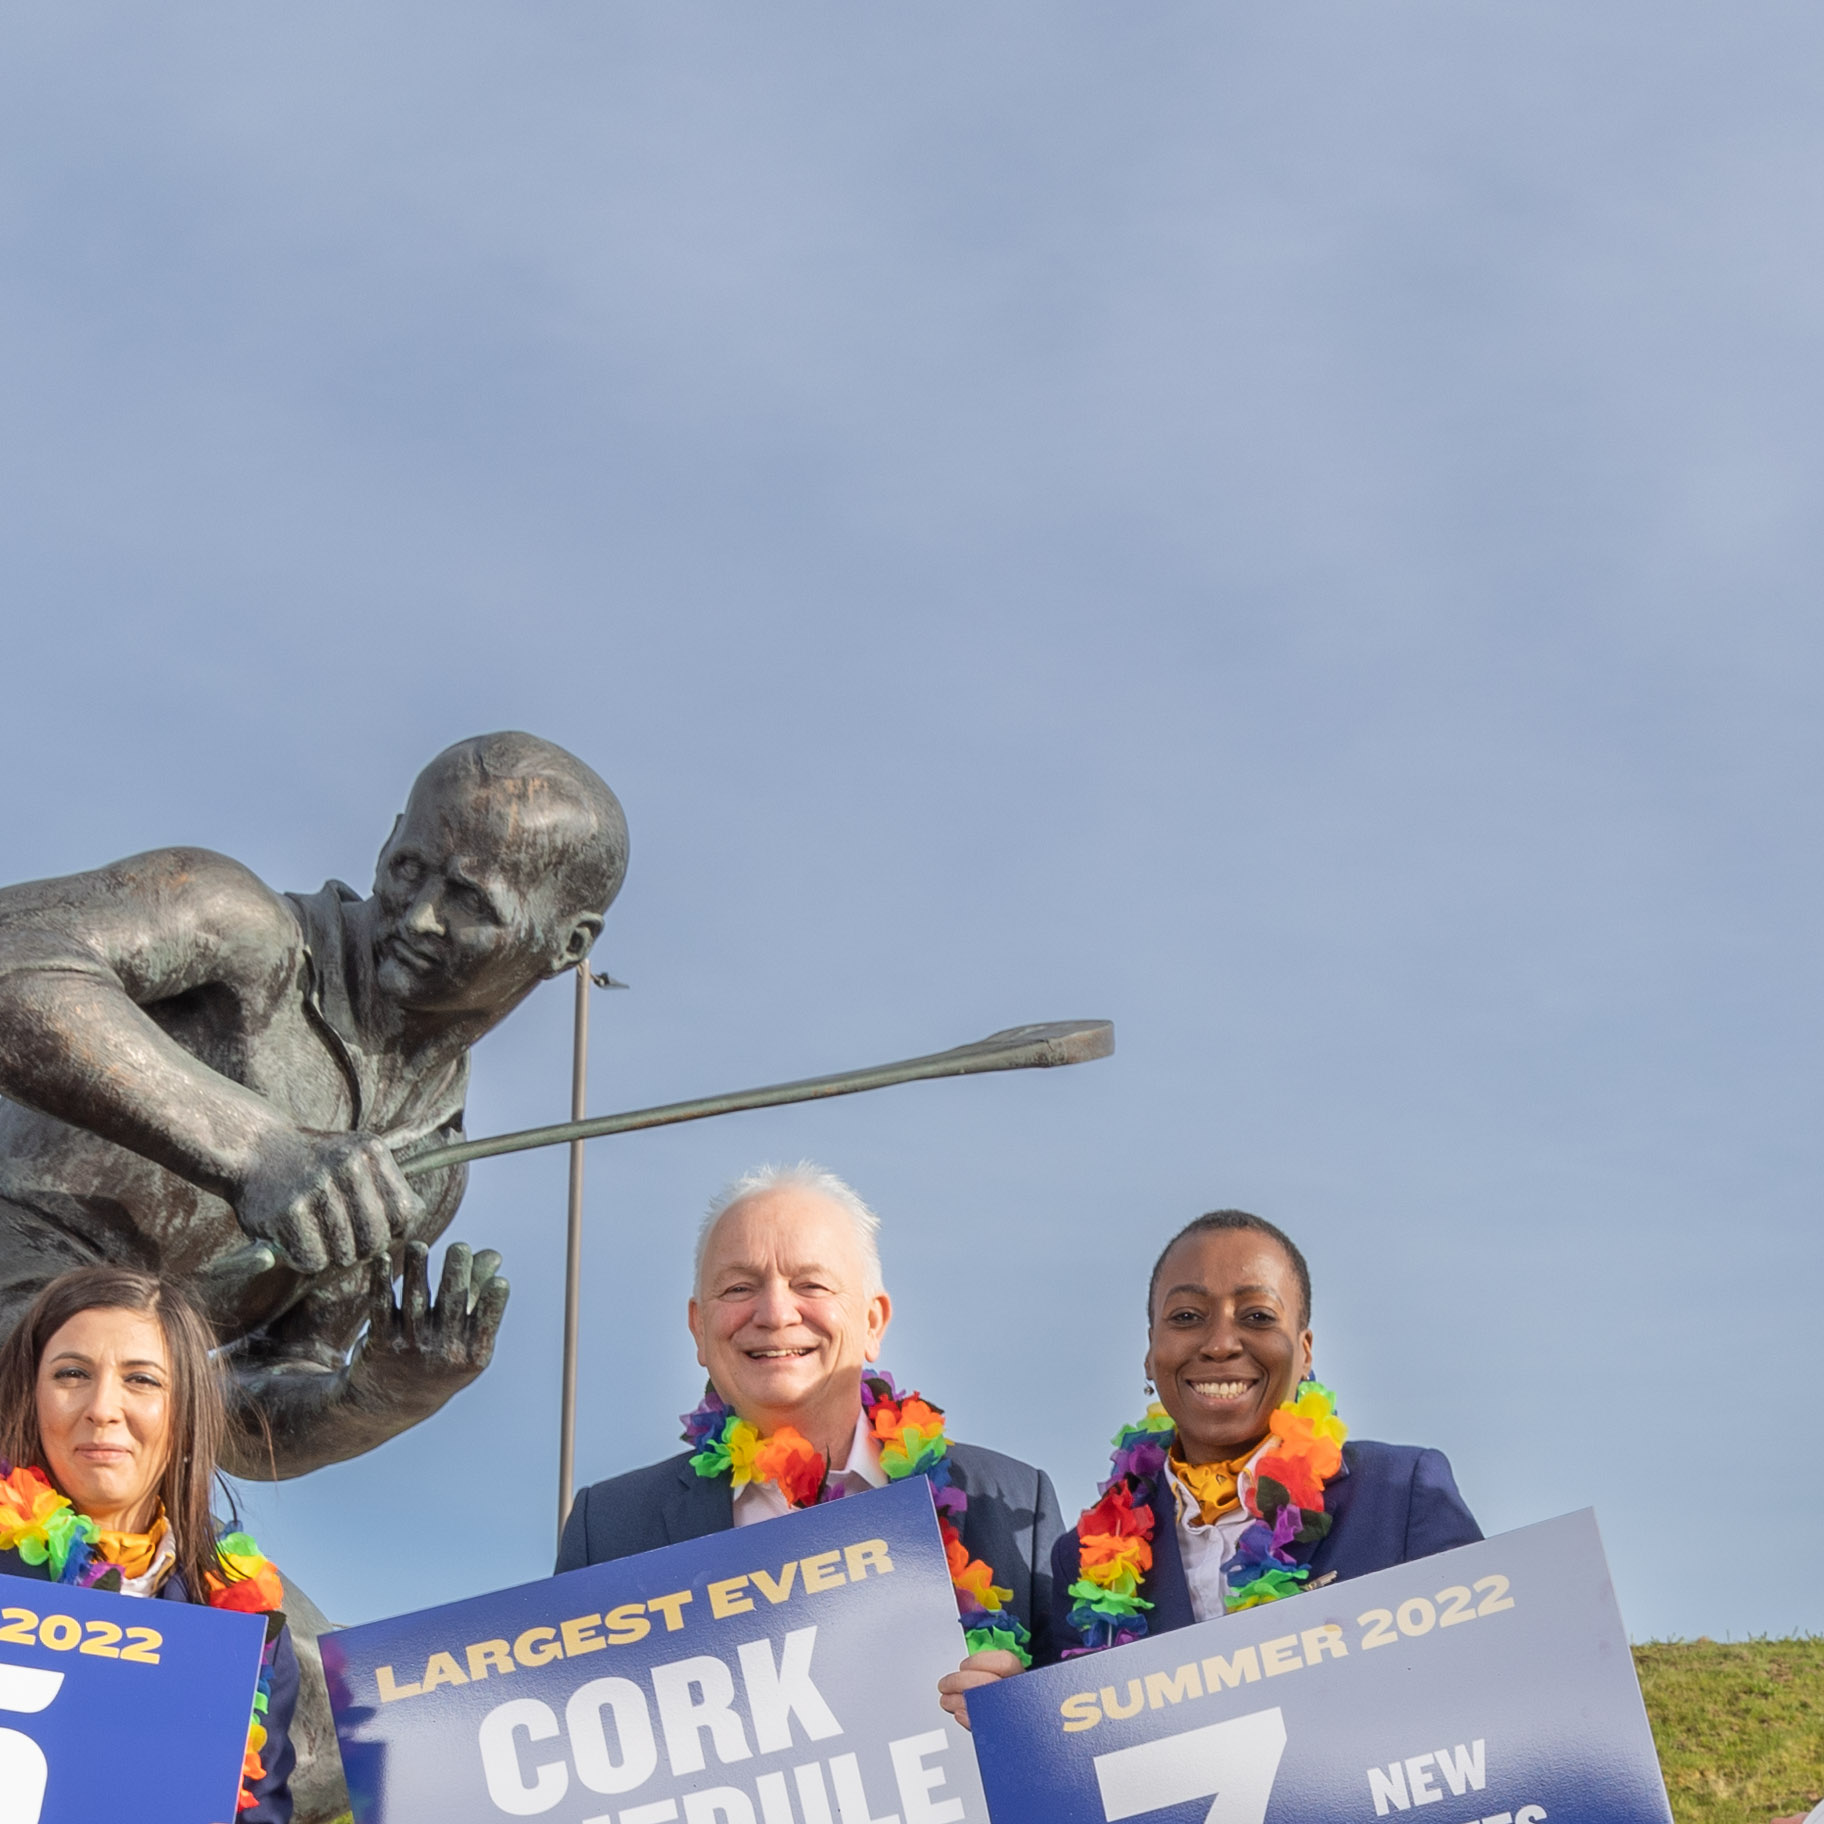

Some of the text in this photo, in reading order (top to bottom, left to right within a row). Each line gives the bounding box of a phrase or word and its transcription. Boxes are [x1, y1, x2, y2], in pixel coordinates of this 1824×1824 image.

[375, 1538, 894, 1703] LARGEST EVER
[1060, 1574, 1516, 1733] SUMMER 2022
[478, 1625, 844, 1816] CORK
[1367, 1738, 1487, 1817] NEW
